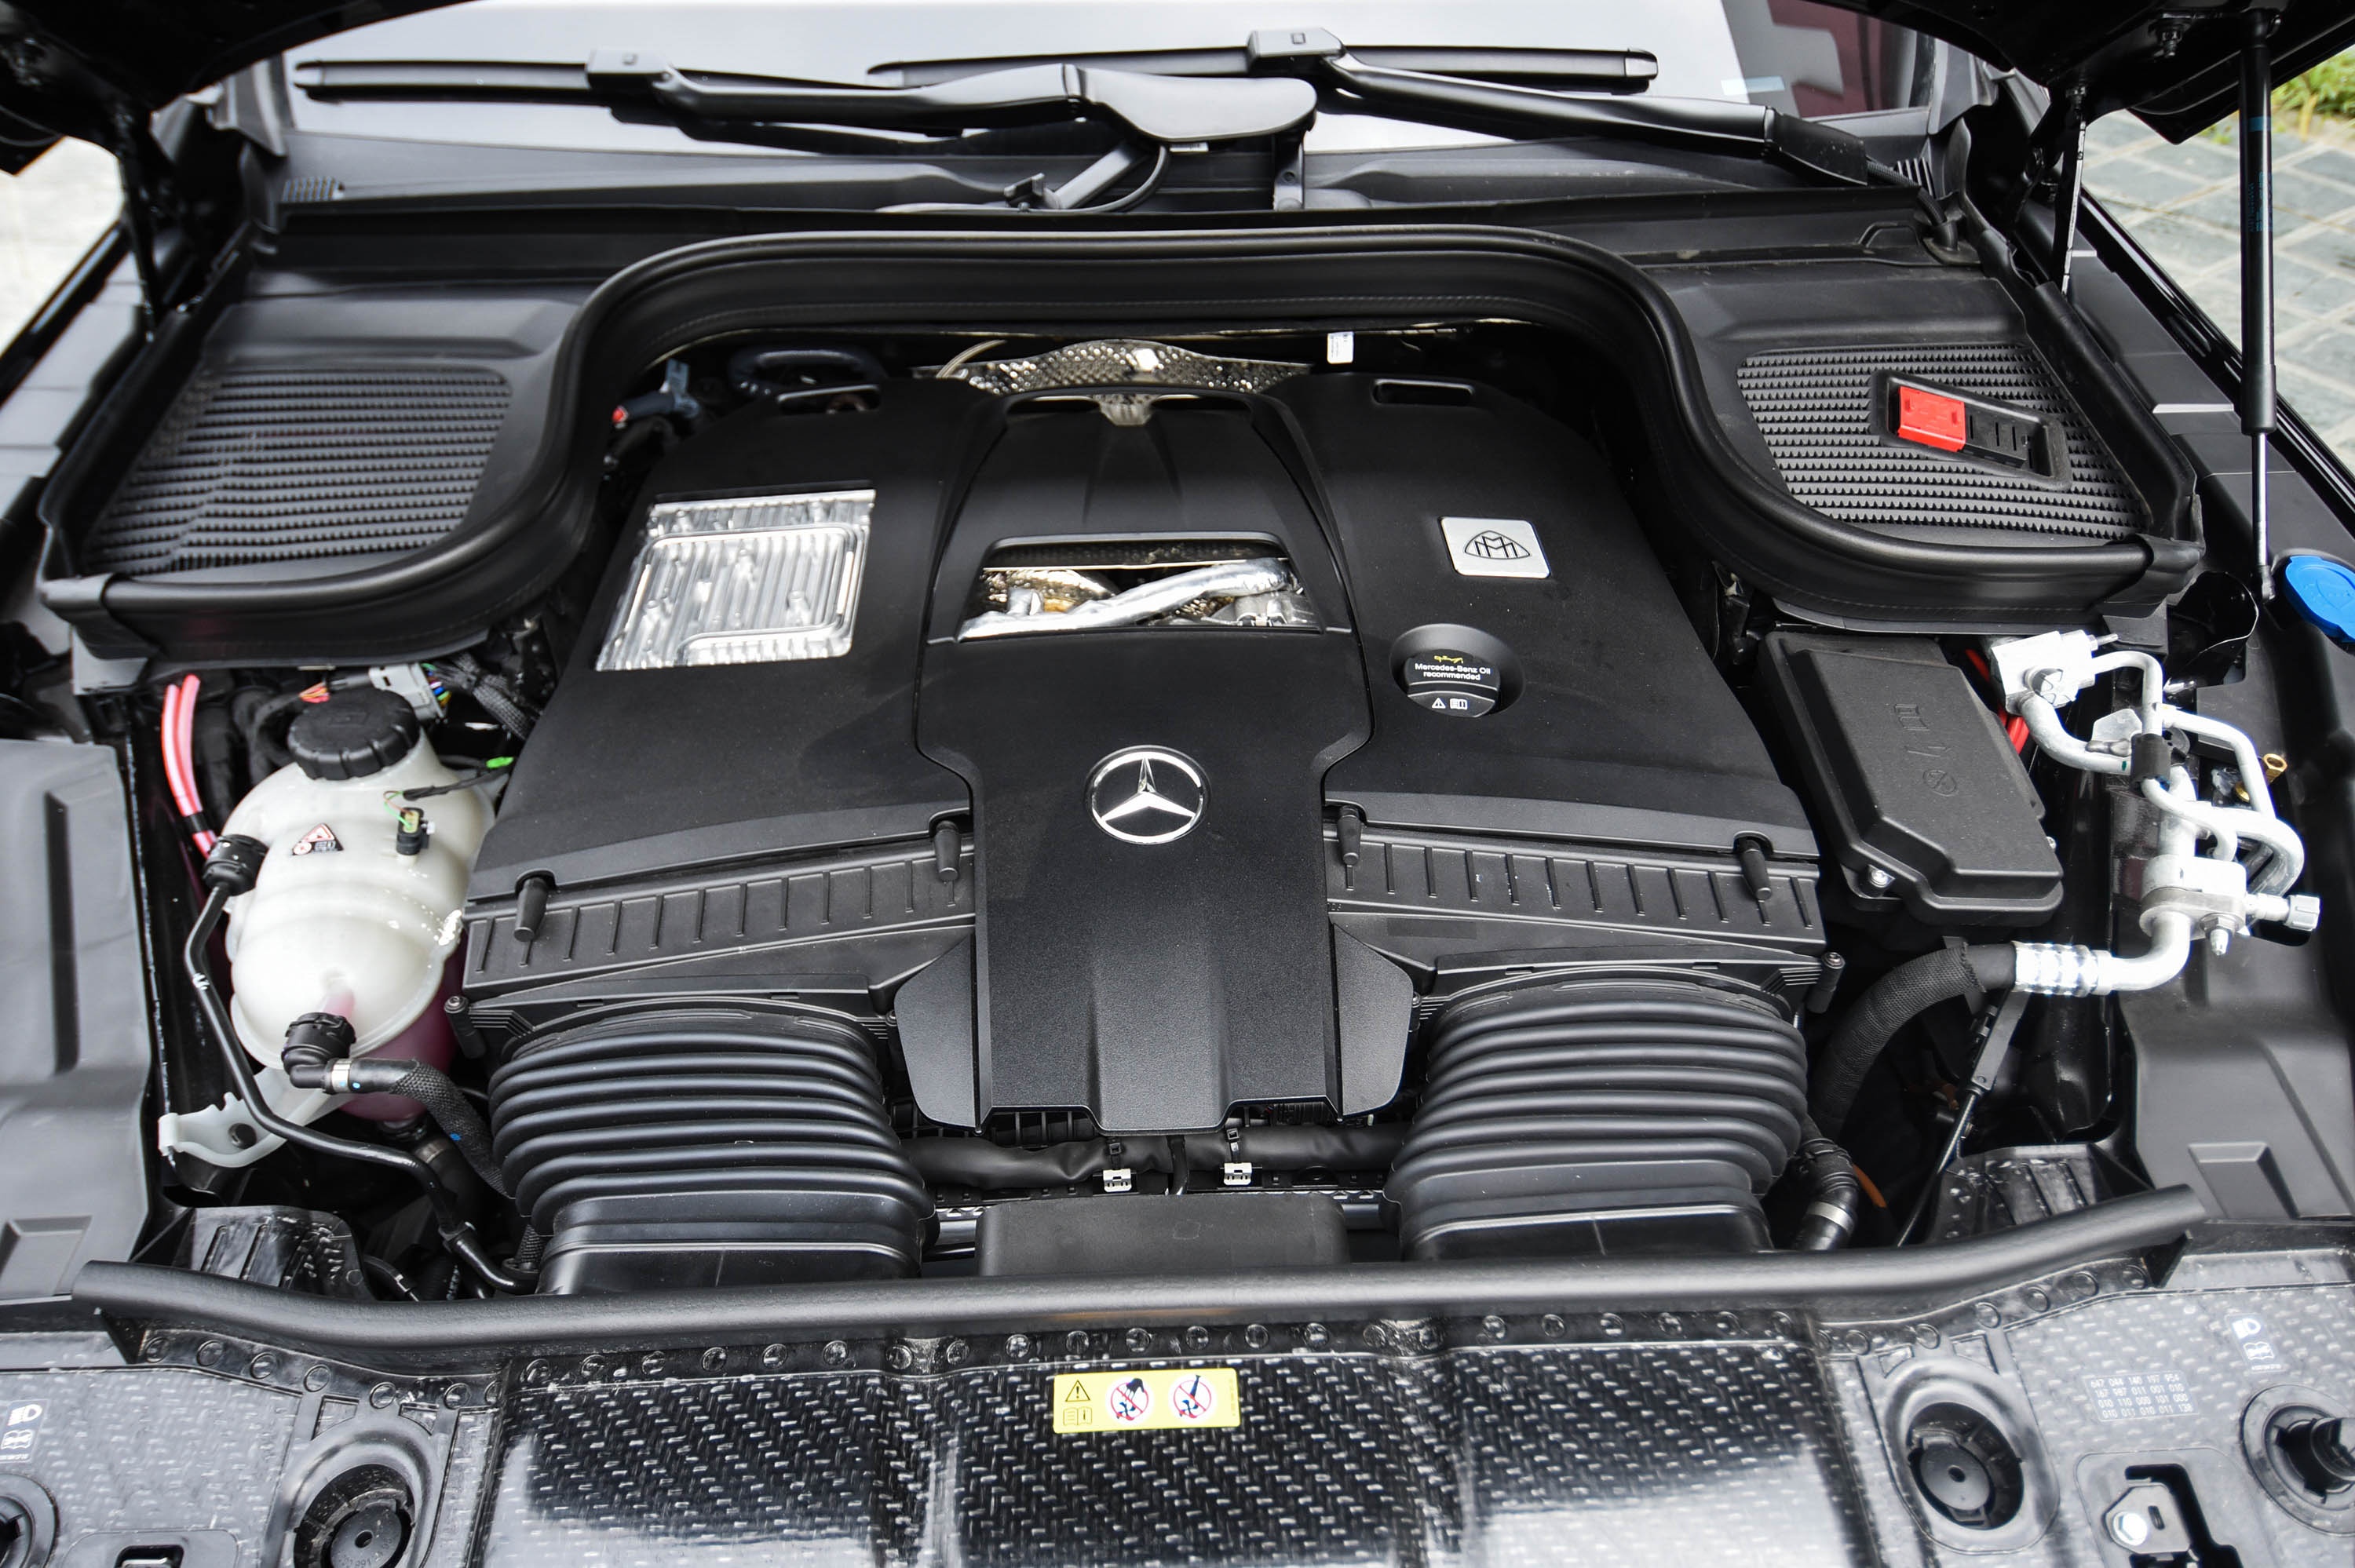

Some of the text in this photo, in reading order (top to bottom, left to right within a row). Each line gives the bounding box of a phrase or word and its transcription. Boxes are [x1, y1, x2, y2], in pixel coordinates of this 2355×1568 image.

[1415, 663, 1491, 675] Mercedes-Benz Oil
[1423, 672, 1481, 680] recommended
[2131, 1387, 2146, 1395] 011
[2150, 1385, 2165, 1394] 001
